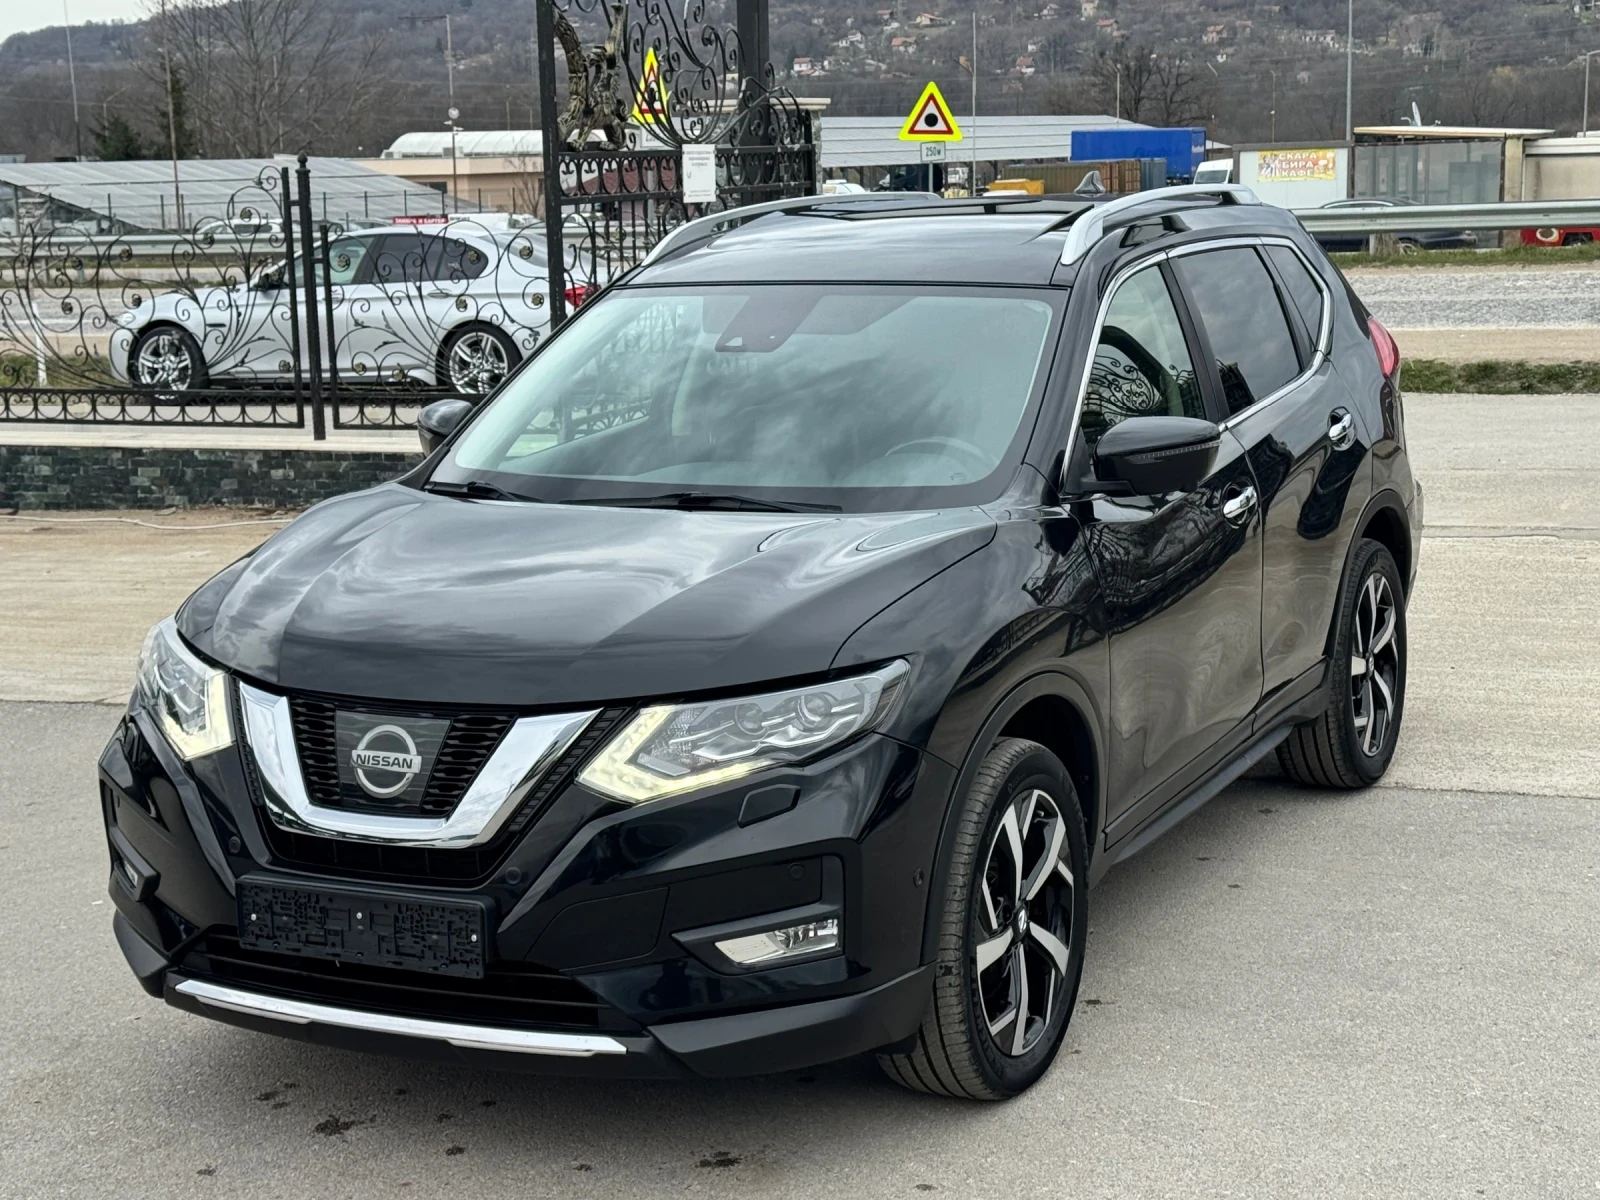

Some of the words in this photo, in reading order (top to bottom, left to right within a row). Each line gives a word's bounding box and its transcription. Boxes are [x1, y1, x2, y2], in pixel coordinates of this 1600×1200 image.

[1279, 151, 1317, 160] СКАРА
[1282, 160, 1314, 169] БИРА
[1282, 169, 1313, 177] КАФЕ
[356, 753, 413, 769] NISSAN
